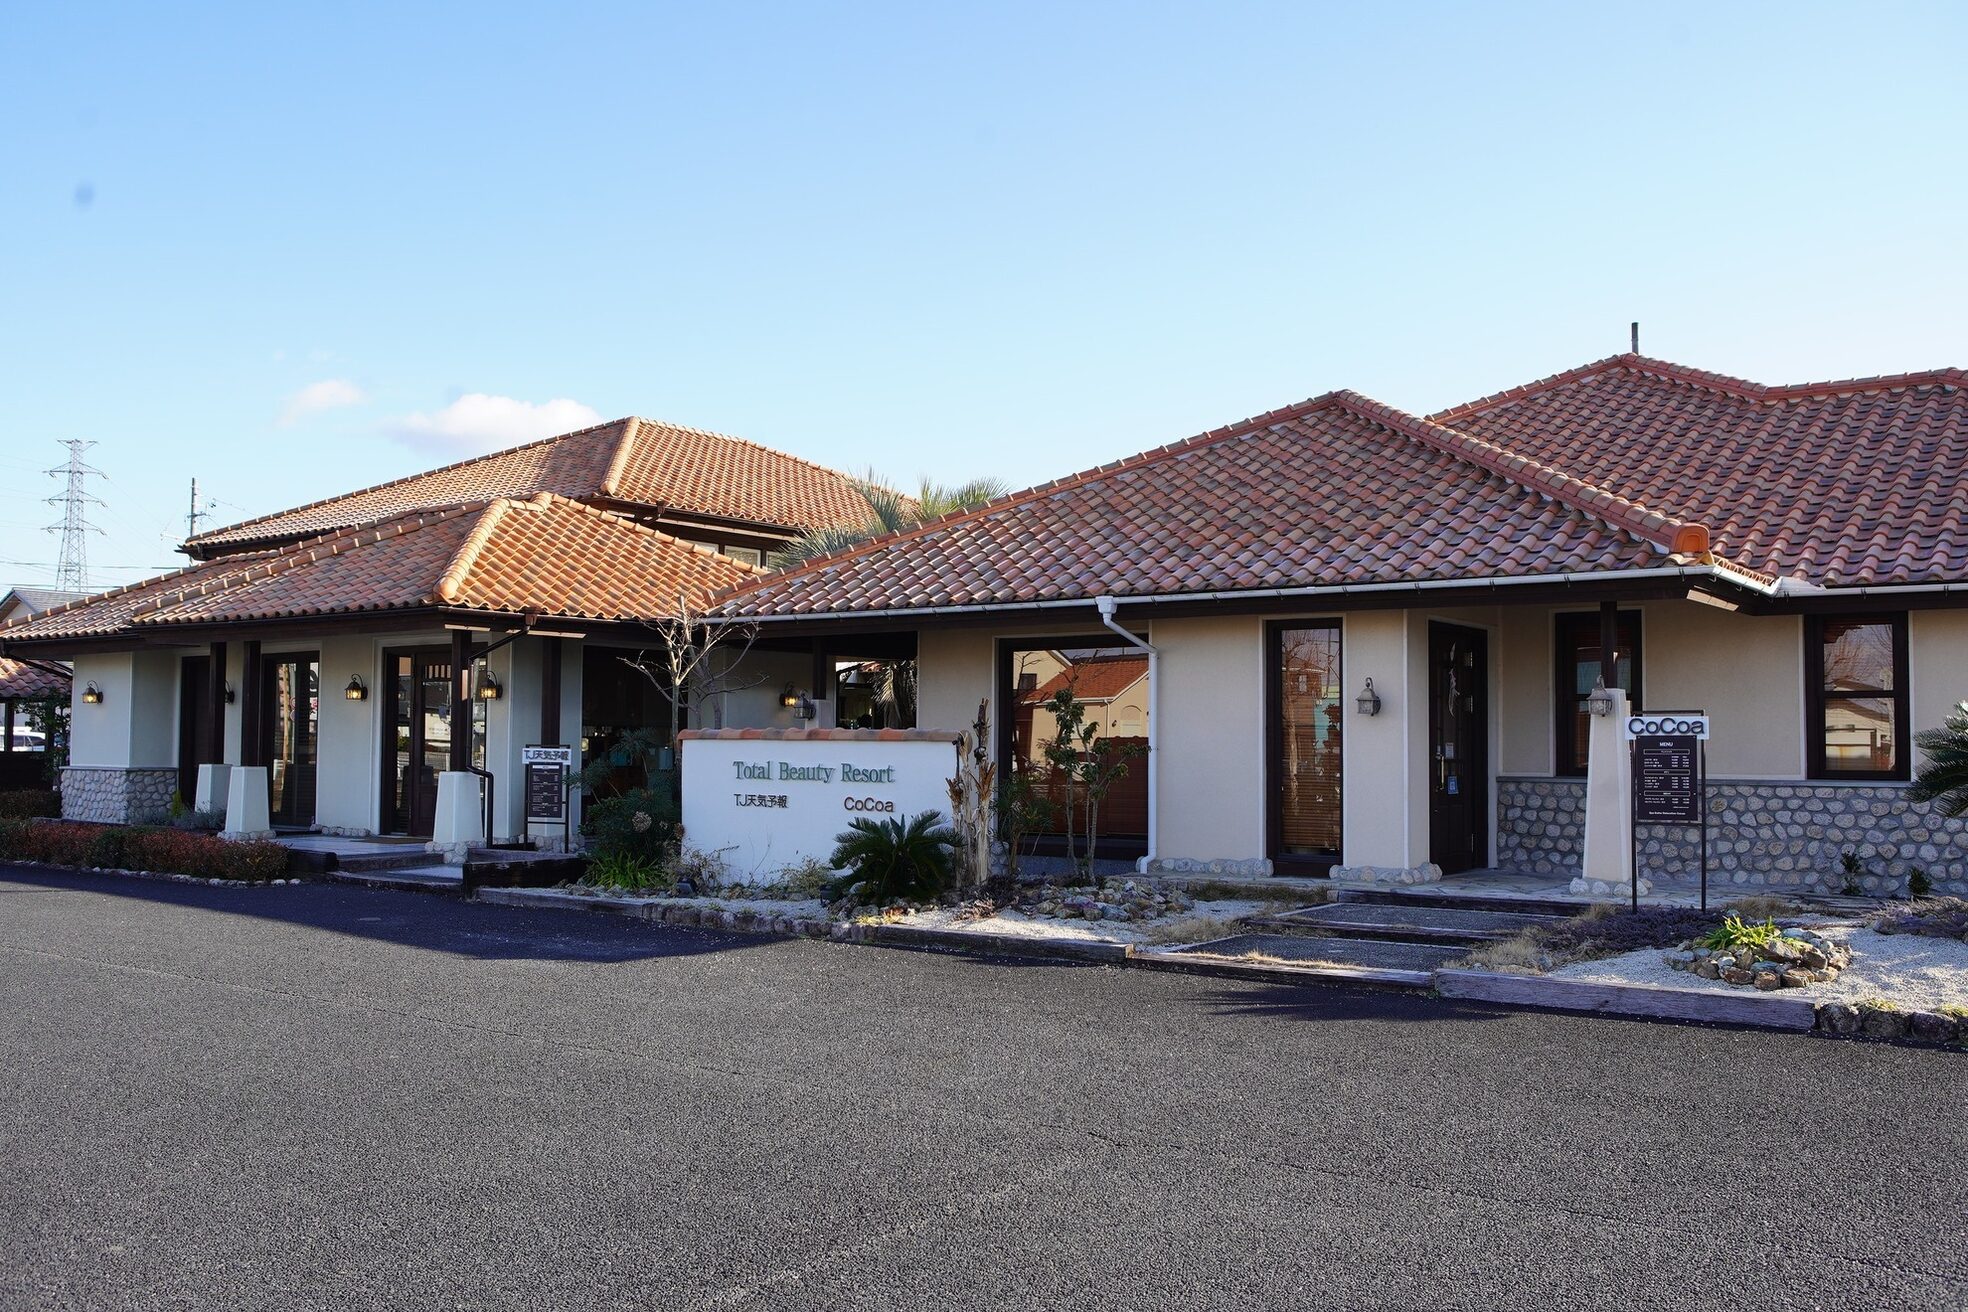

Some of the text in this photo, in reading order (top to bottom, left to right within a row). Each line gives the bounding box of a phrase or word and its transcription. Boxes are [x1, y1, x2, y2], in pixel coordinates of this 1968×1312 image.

[1628, 717, 1705, 735] CoCoa
[733, 760, 895, 783] Total Beauty Resort
[733, 794, 788, 808] TJ天気予報
[843, 796, 895, 812] CoCoa
